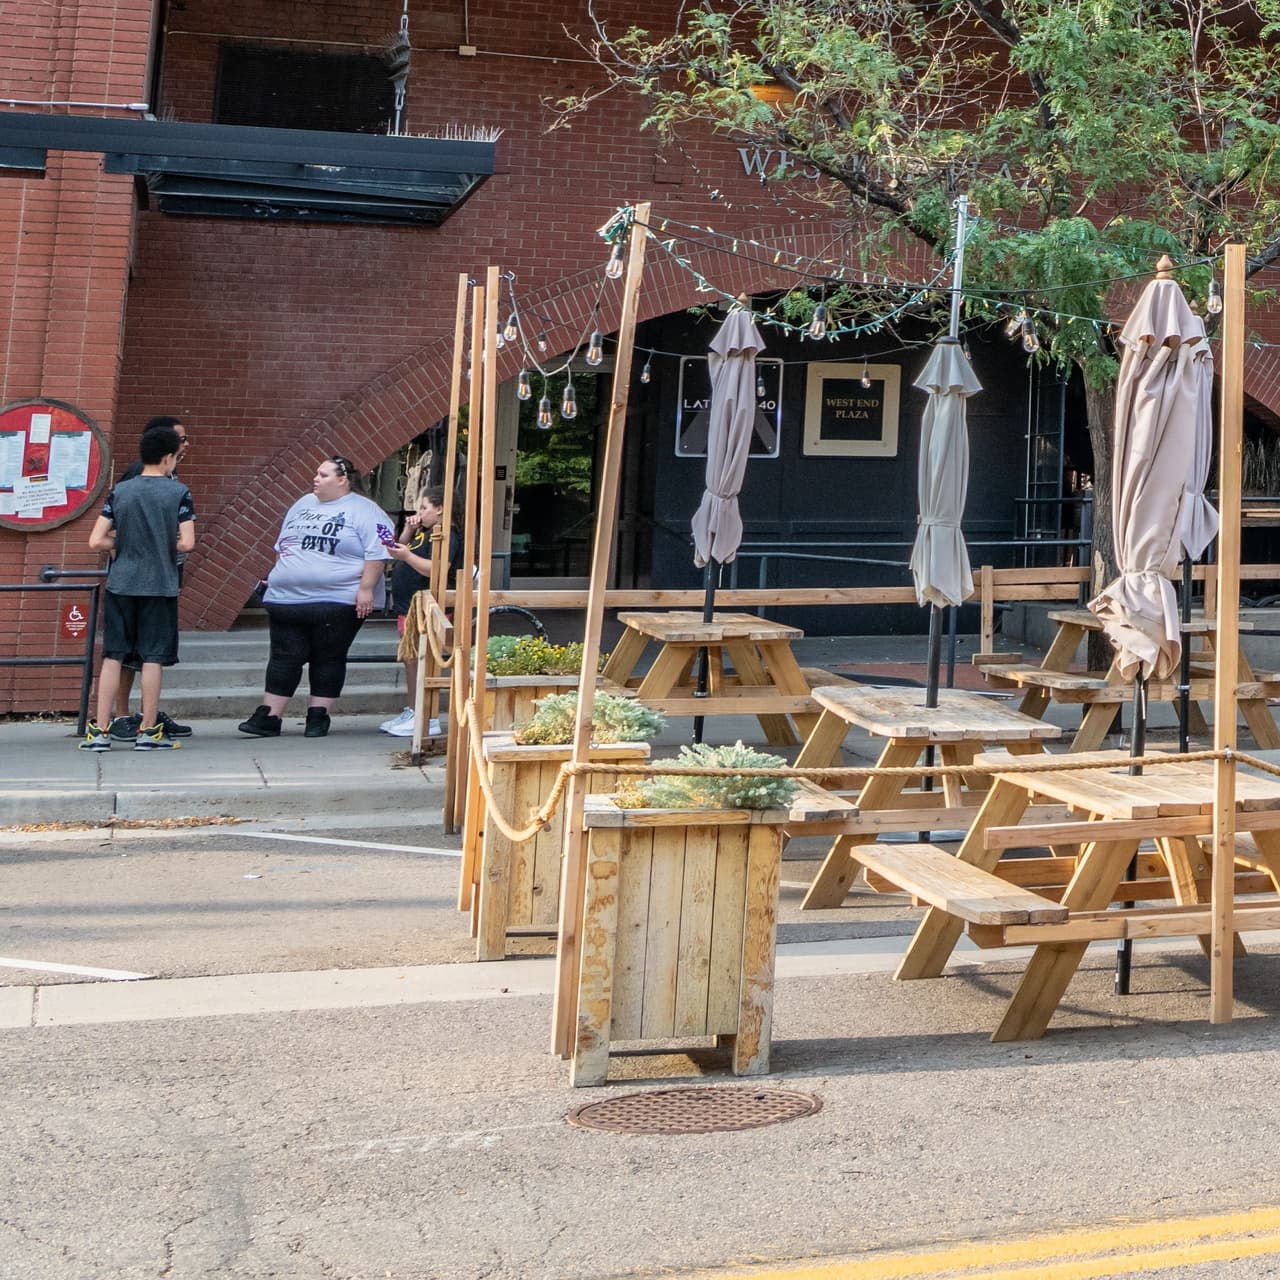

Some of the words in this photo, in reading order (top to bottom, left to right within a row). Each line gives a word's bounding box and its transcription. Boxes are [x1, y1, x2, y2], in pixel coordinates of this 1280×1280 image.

[758, 400, 776, 410] 40
[825, 398, 854, 408] WEST
[856, 399, 879, 408] END
[835, 410, 869, 419] PLAZA
[322, 522, 345, 537] OF
